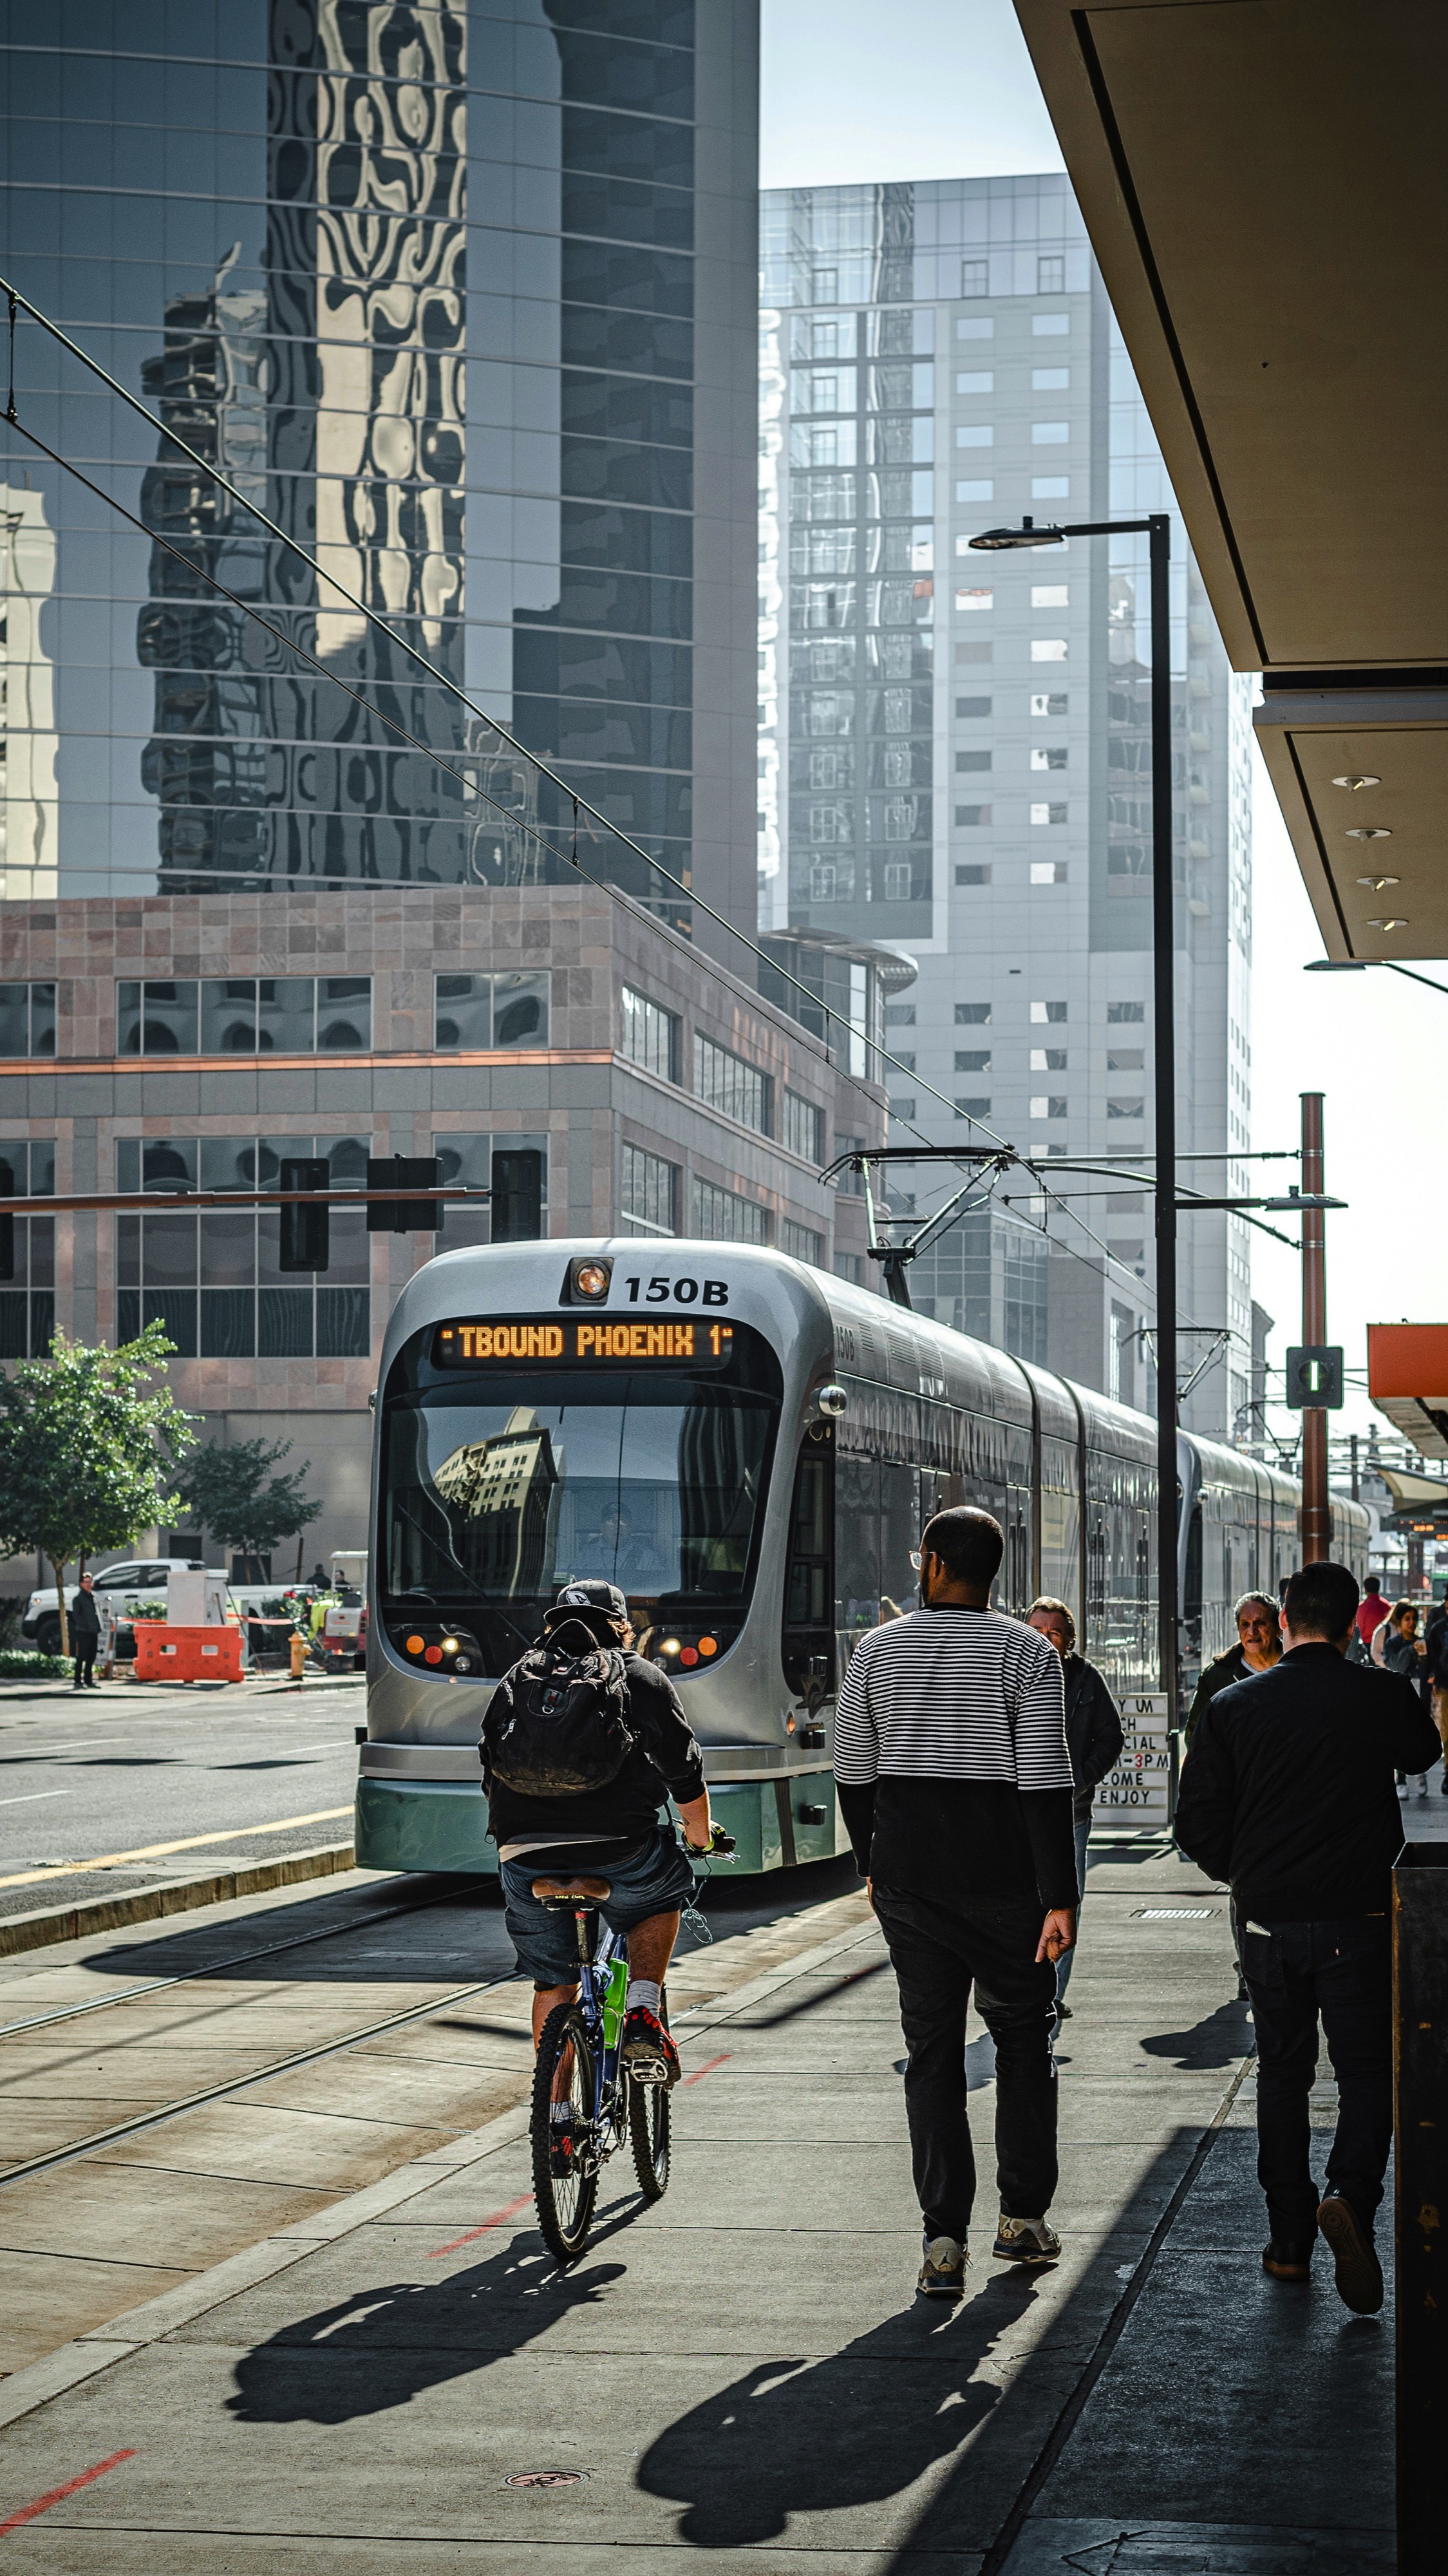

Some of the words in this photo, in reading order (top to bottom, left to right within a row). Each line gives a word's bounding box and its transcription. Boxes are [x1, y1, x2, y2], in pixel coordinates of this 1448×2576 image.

[625, 1277, 729, 1306] 150B
[458, 1325, 564, 1358] TBOUND
[577, 1325, 693, 1356] PHOENIX
[836, 1325, 855, 1361] 150B
[1100, 1790, 1149, 1804] ENJOY
